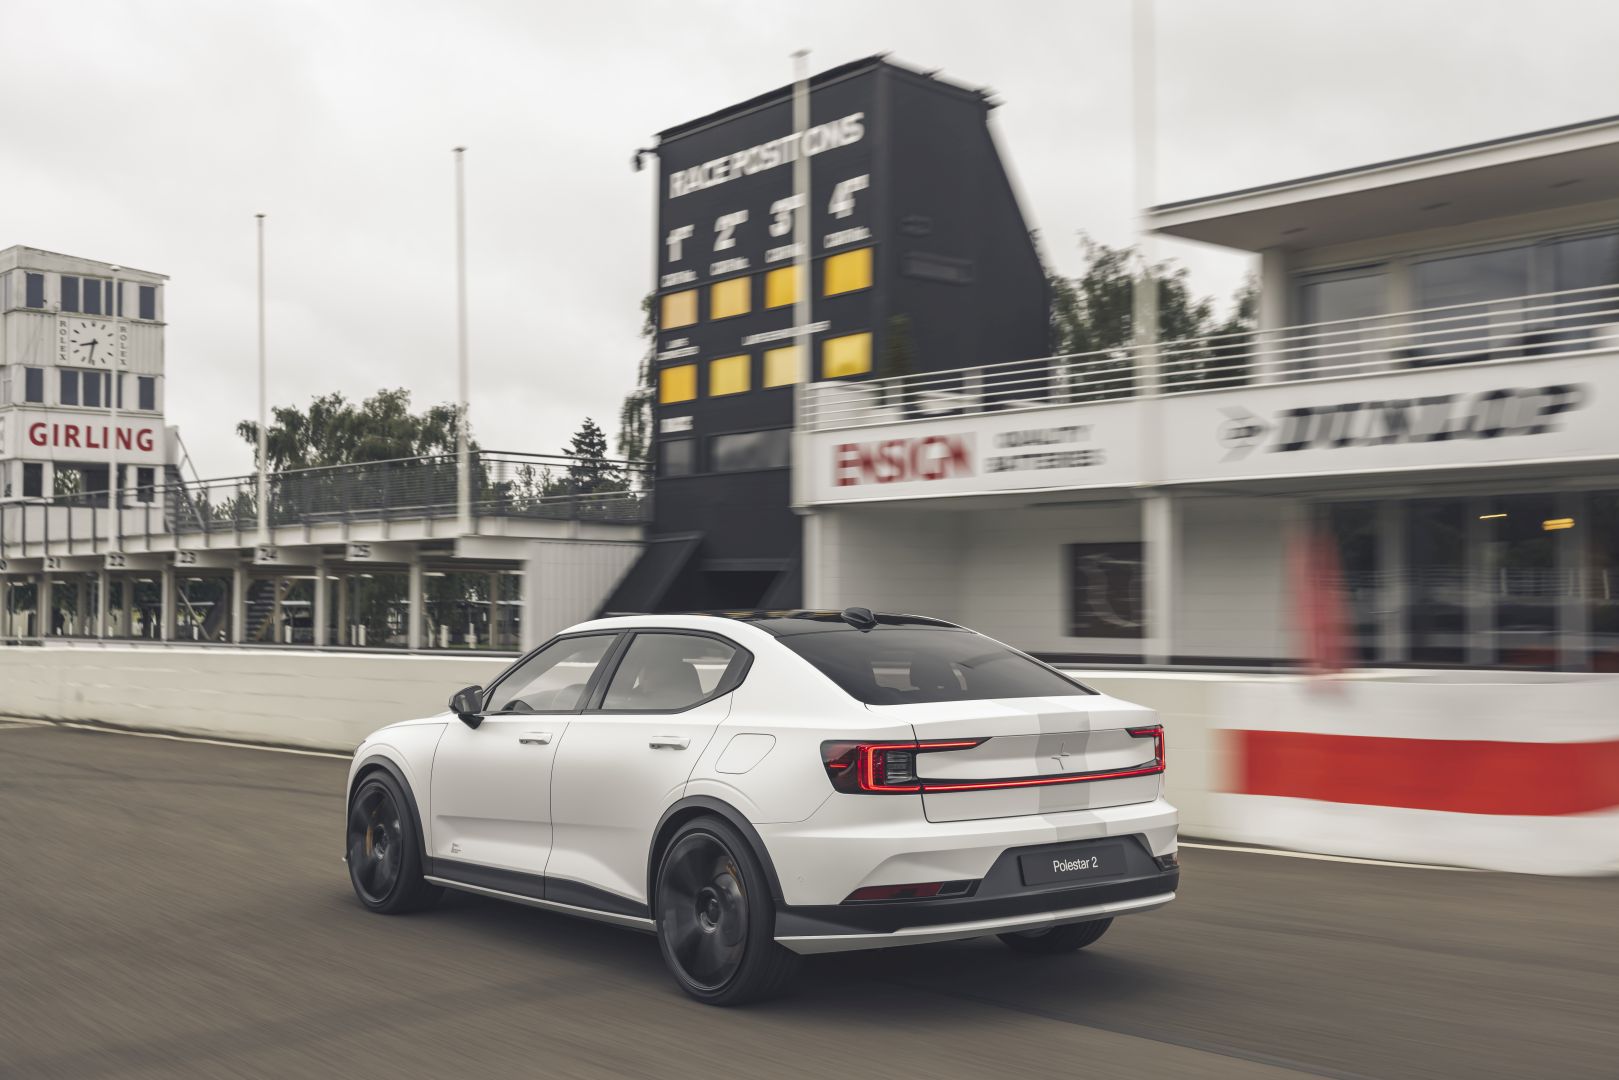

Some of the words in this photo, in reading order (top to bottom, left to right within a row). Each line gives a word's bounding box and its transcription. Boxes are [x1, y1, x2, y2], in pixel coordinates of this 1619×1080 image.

[668, 157, 731, 199] RACE
[59, 321, 67, 361] ROLEX
[120, 326, 128, 366] ROLEX
[29, 422, 155, 452] GIRLING
[1268, 382, 1590, 454] DUNLOP
[833, 431, 977, 487] ENSIGN
[260, 548, 276, 562] 24
[1052, 859, 1090, 873] Polestar
[1091, 856, 1098, 868] 2
